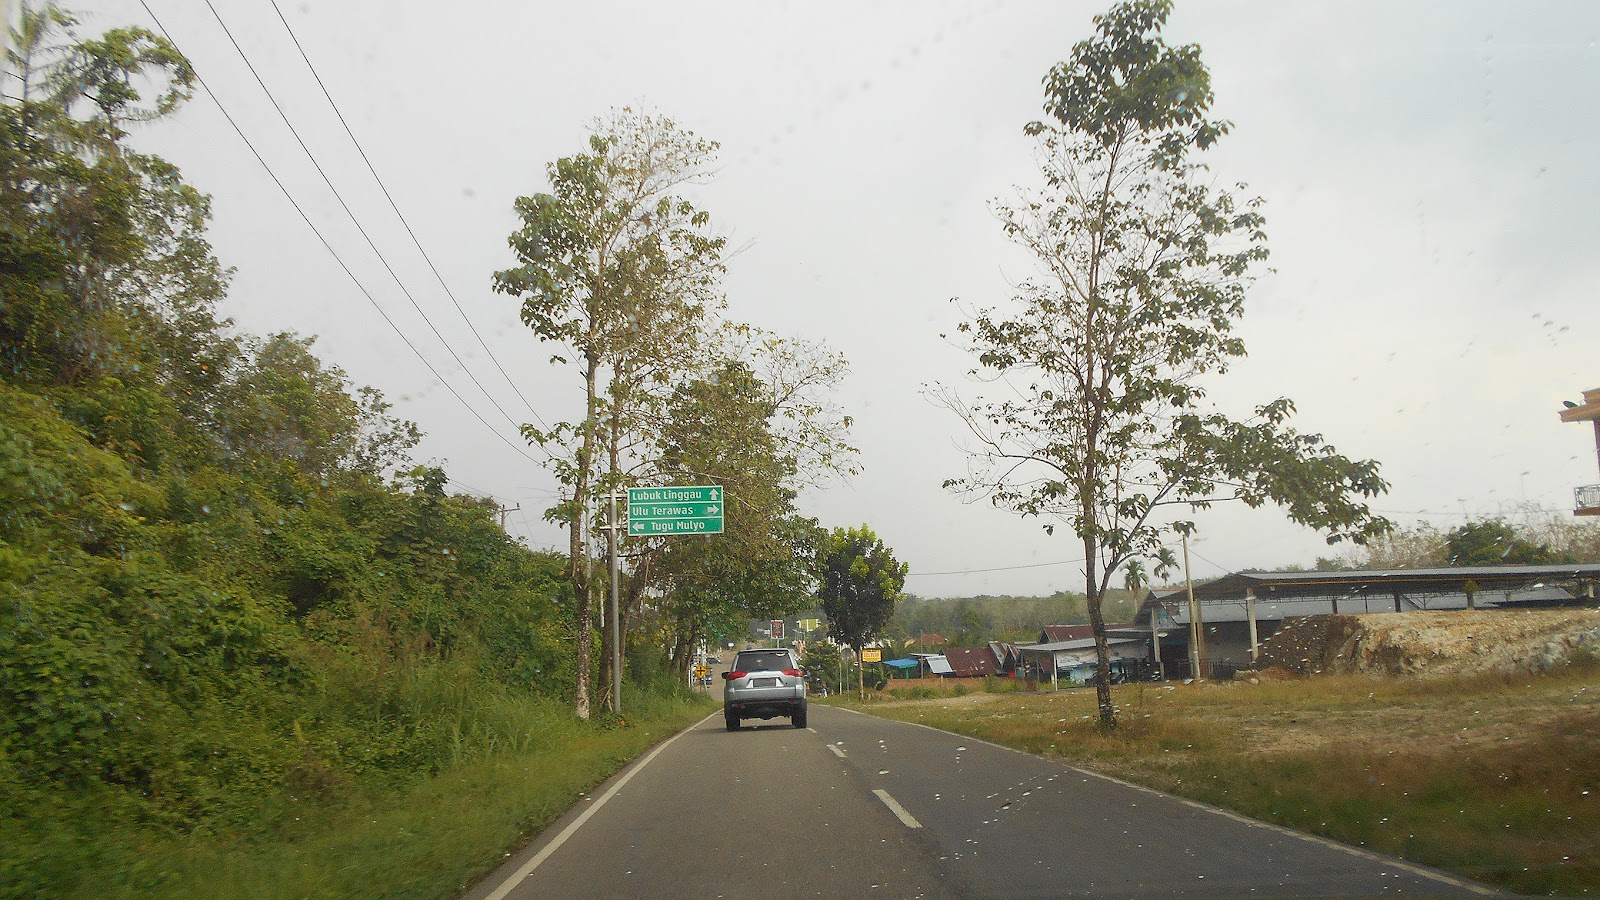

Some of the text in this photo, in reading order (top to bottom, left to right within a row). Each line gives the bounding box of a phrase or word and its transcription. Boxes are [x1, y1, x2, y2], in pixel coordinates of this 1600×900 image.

[632, 490, 701, 501] Lubuk Linggau
[632, 506, 693, 516] Ulu Terawas
[651, 520, 705, 532] Tugu Mulyo
